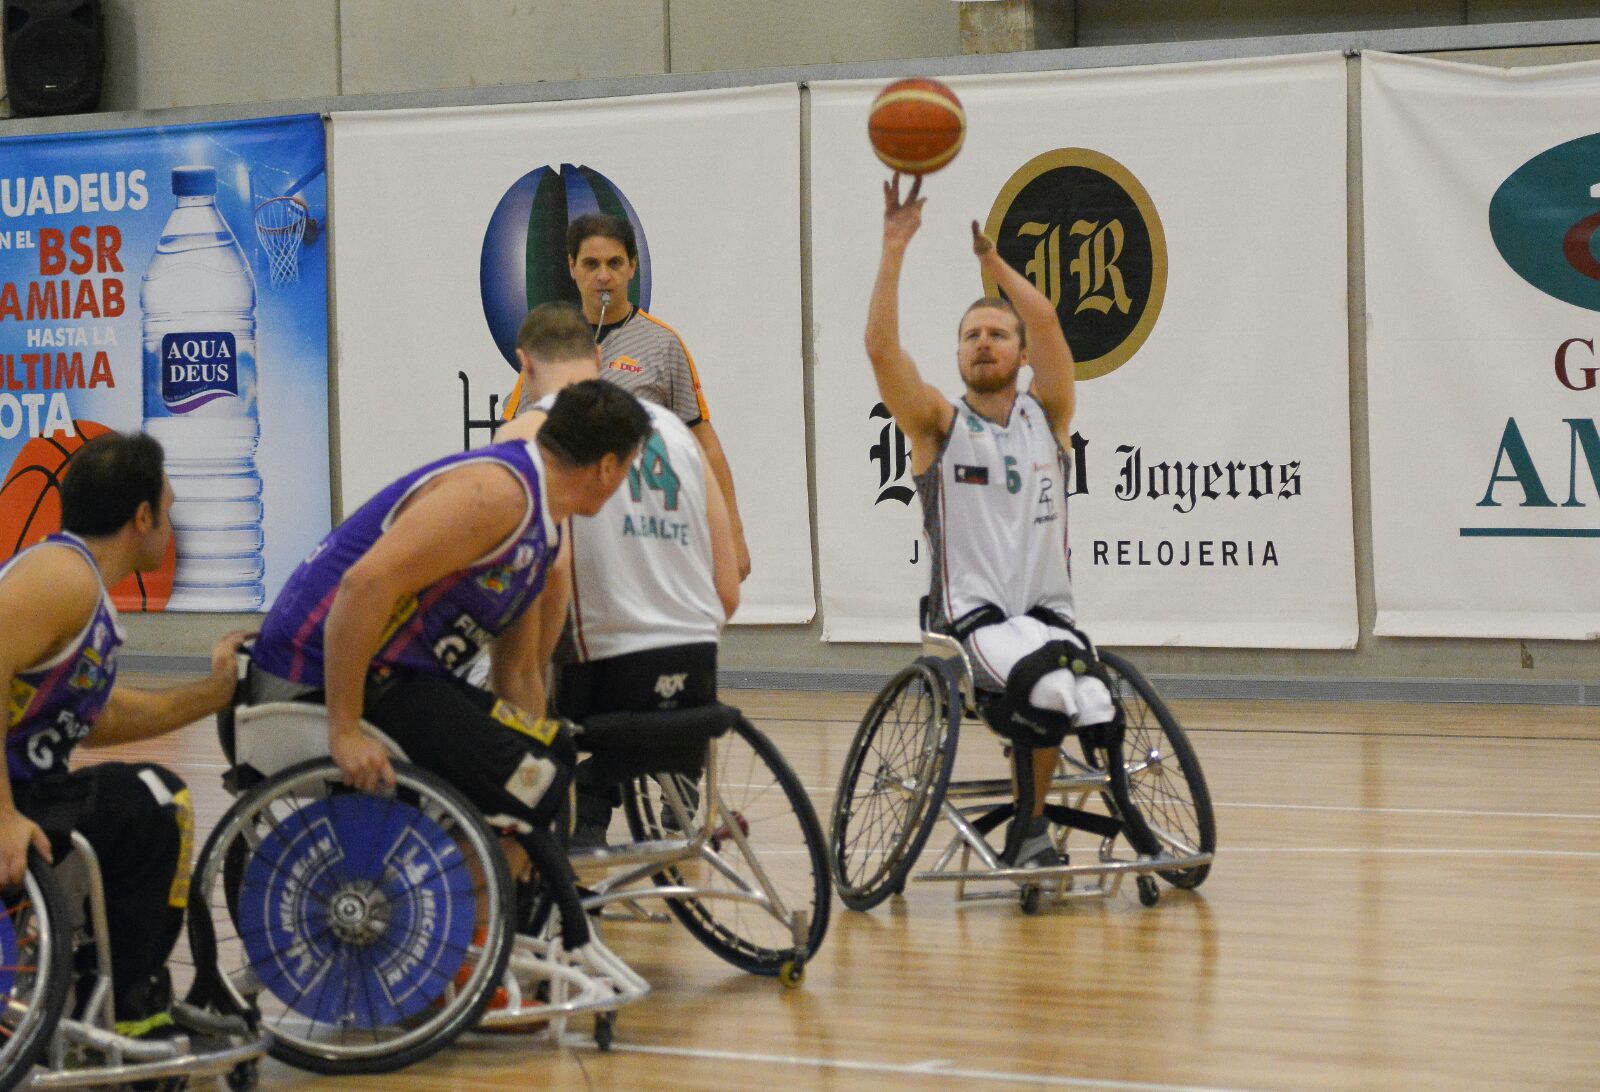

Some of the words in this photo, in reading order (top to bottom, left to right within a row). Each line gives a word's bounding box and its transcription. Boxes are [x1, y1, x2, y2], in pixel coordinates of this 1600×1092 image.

[16, 230, 36, 249] EL
[39, 225, 124, 276] BSR
[0, 278, 125, 321] AMIAB
[27, 327, 88, 348] HASTA
[93, 326, 118, 345] LA
[168, 340, 231, 362] AQUA
[170, 364, 229, 383] DEUS
[1003, 455, 1022, 495] 6
[1114, 444, 1302, 514] Joyeros
[1093, 540, 1279, 566] RELOJERIA
